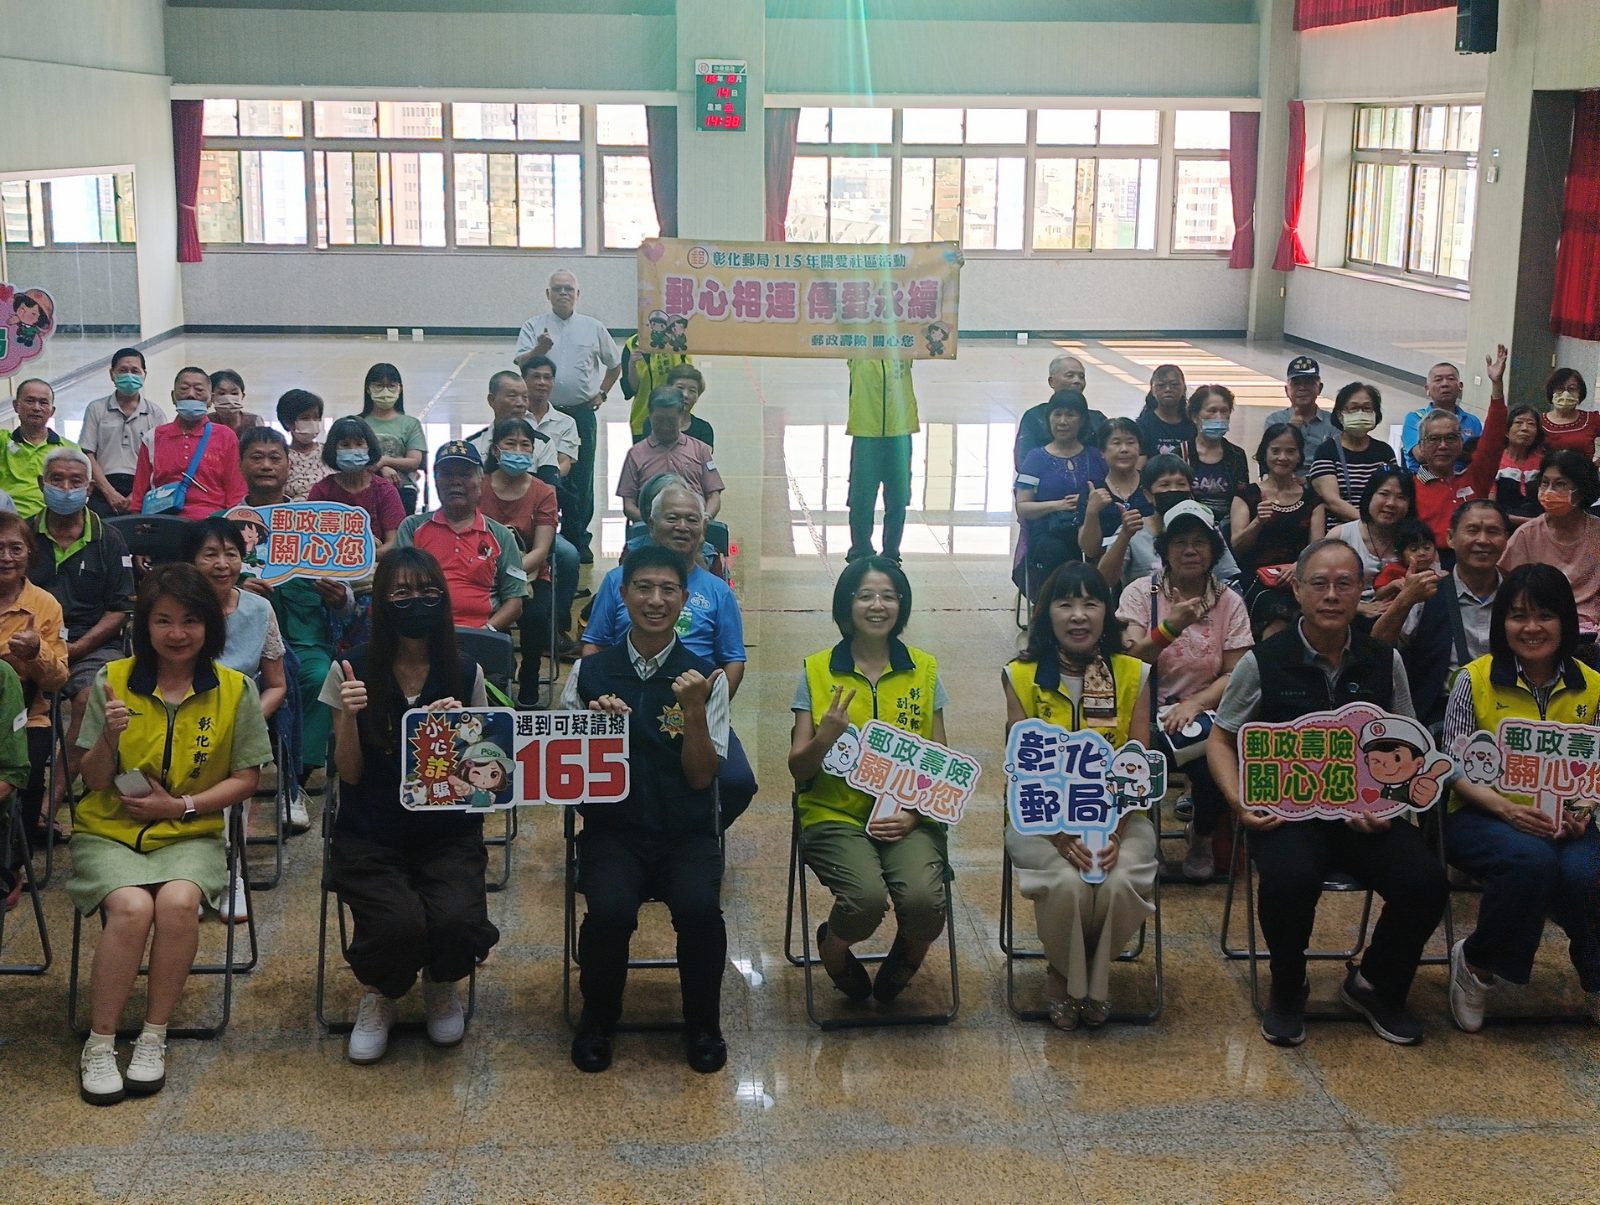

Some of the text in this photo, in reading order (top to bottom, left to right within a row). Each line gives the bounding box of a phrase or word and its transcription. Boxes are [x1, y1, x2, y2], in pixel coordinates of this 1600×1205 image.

[705, 116, 742, 128] 14:38
[665, 277, 939, 319] 郵心相連 傳愛永續
[811, 334, 914, 347] 郵政壽險 關心您
[272, 509, 365, 534] 郵政壽險
[270, 534, 365, 565] 關心您
[516, 713, 625, 736] 遇到可疑請撥
[896, 697, 908, 730] 副局
[481, 748, 500, 757] POST
[867, 727, 974, 787] 郵政壽險
[1018, 731, 1102, 779] 彰化
[1246, 729, 1353, 759] 郵政壽險
[1505, 727, 1600, 759] 郵政壽
[425, 722, 450, 798] 小心詐騙
[516, 738, 625, 800] 165
[855, 752, 963, 817] 關心您
[1247, 763, 1356, 801] 關心您
[1020, 783, 1109, 823] 郵局
